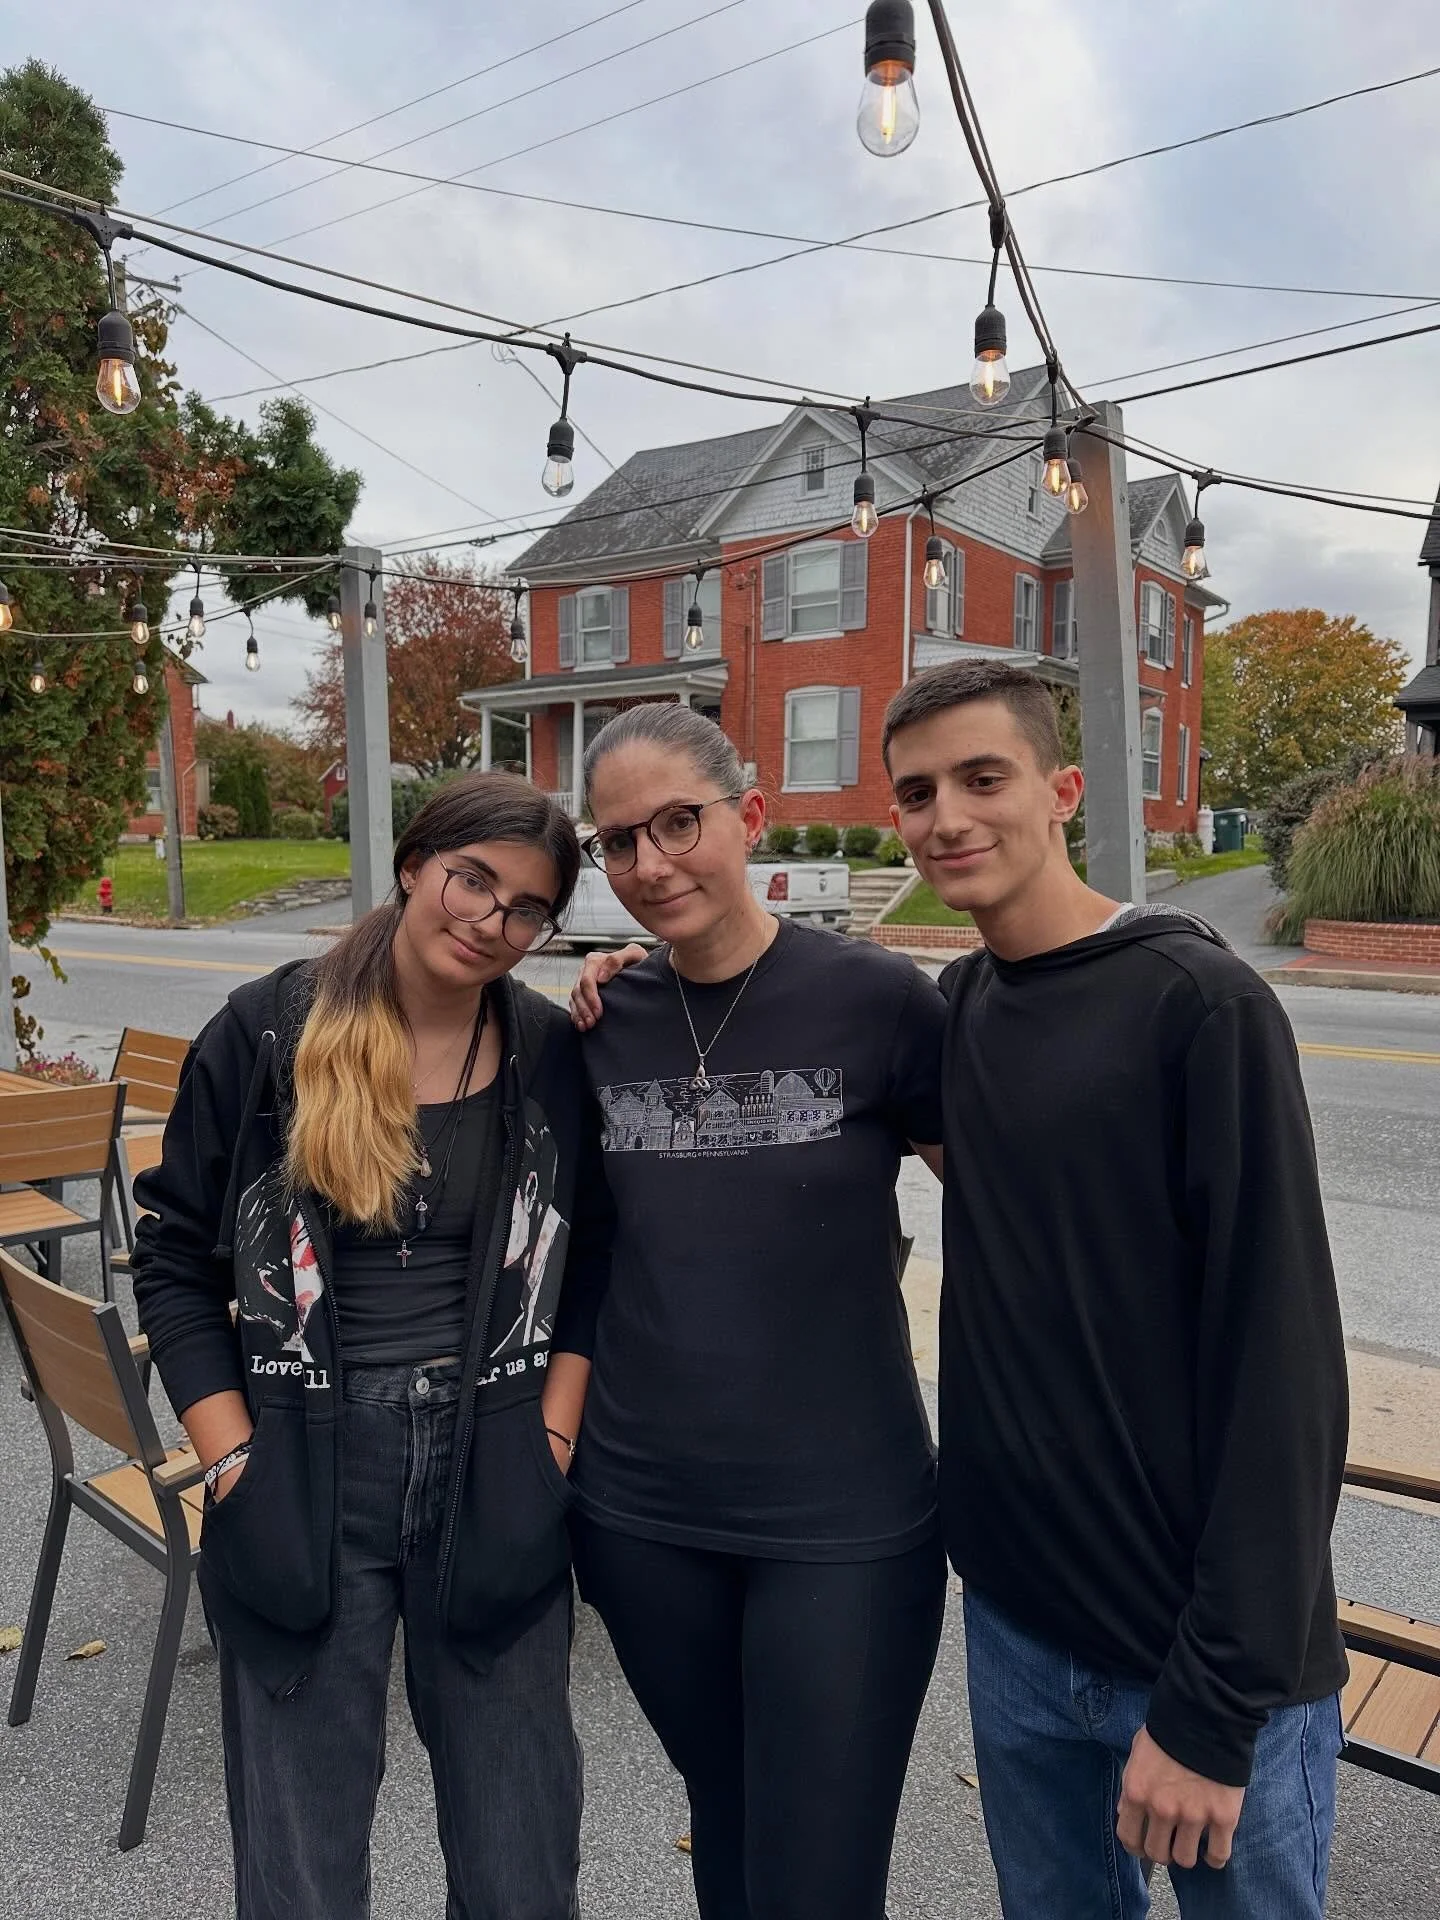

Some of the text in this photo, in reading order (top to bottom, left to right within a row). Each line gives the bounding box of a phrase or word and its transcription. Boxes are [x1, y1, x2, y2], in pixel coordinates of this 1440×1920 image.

[658, 1149, 749, 1159] STRASBURG PENNSYLVANIA
[250, 1355, 304, 1376] Love
[505, 1358, 527, 1376] us
